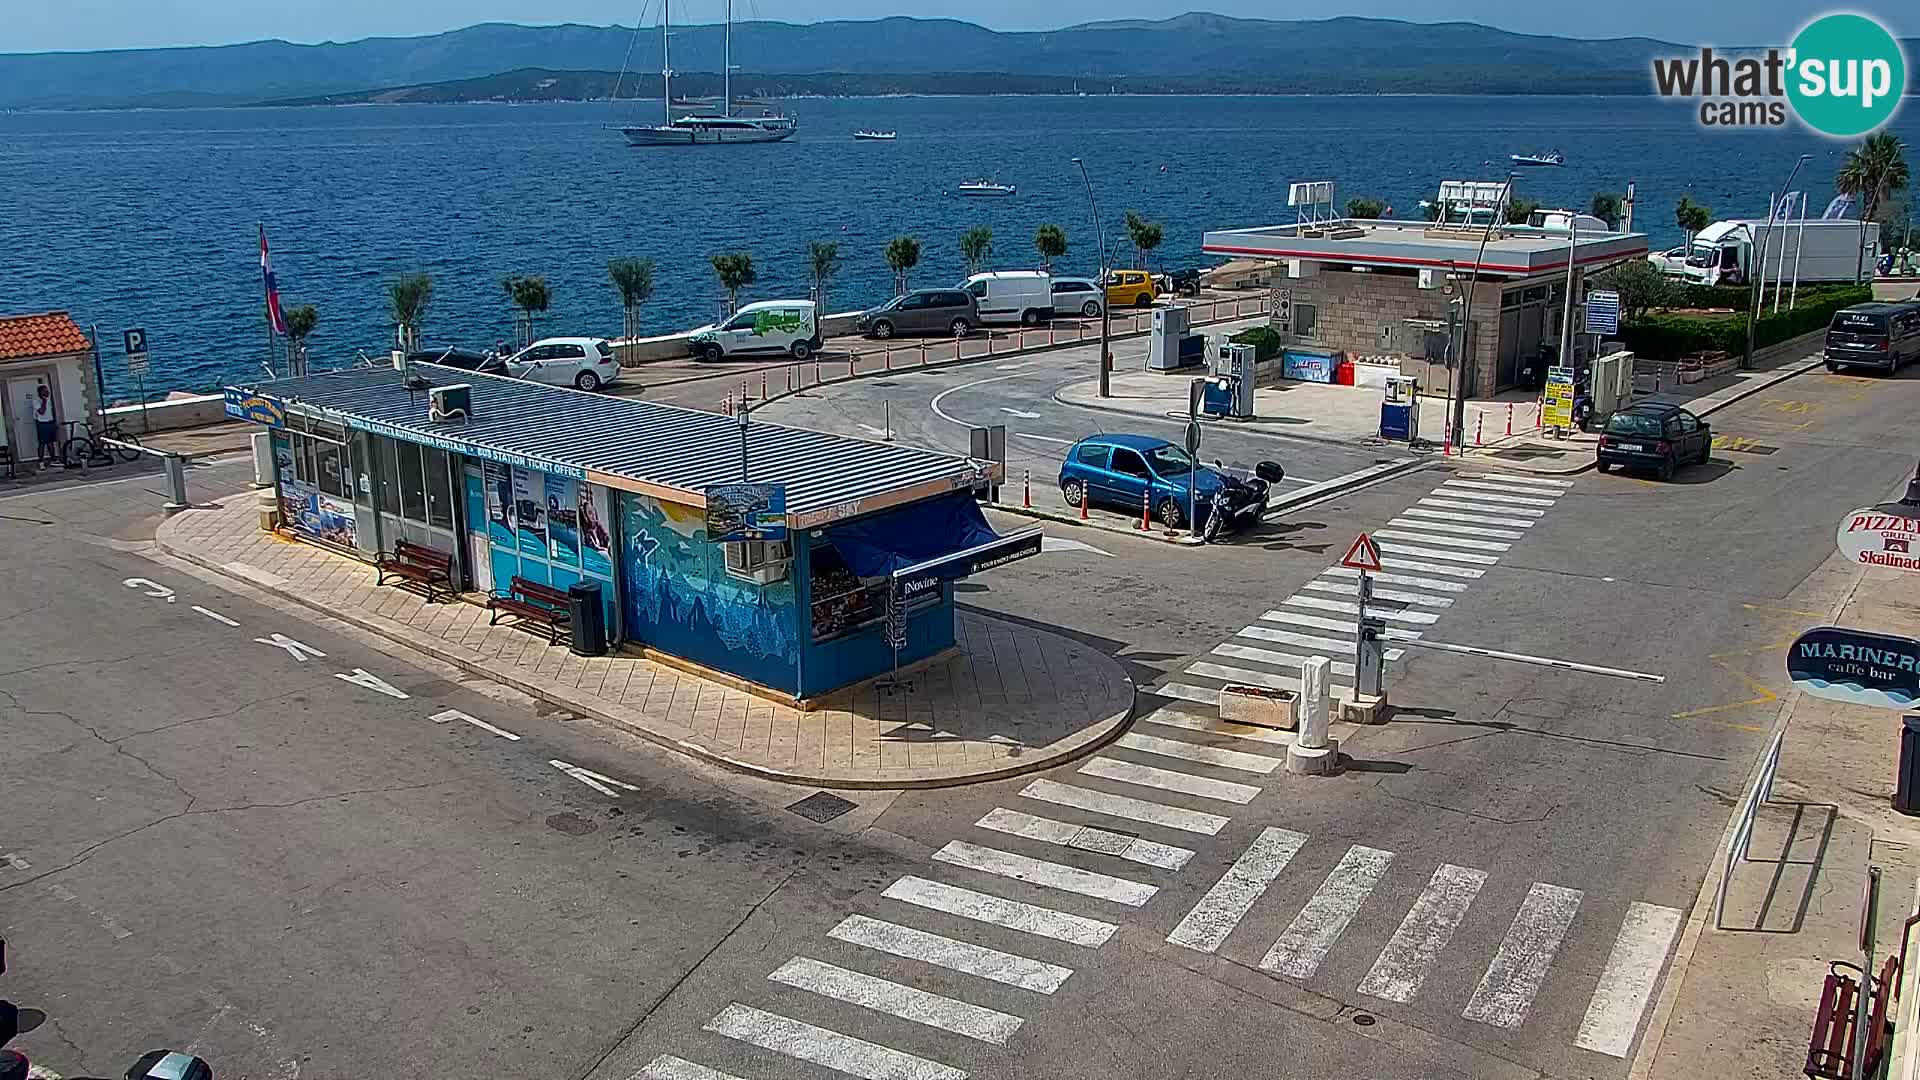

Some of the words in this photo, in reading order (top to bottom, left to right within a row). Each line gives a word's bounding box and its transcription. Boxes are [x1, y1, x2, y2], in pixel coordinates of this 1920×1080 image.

[129, 332, 141, 350] P
[493, 450, 525, 465] STATION
[528, 458, 553, 471] TICKET
[554, 464, 582, 477] OFFICE
[1847, 515, 1920, 534] PIZZE
[1881, 531, 1917, 541] GRILL
[1828, 663, 1865, 676] caffe
[1870, 666, 1896, 681] bar
